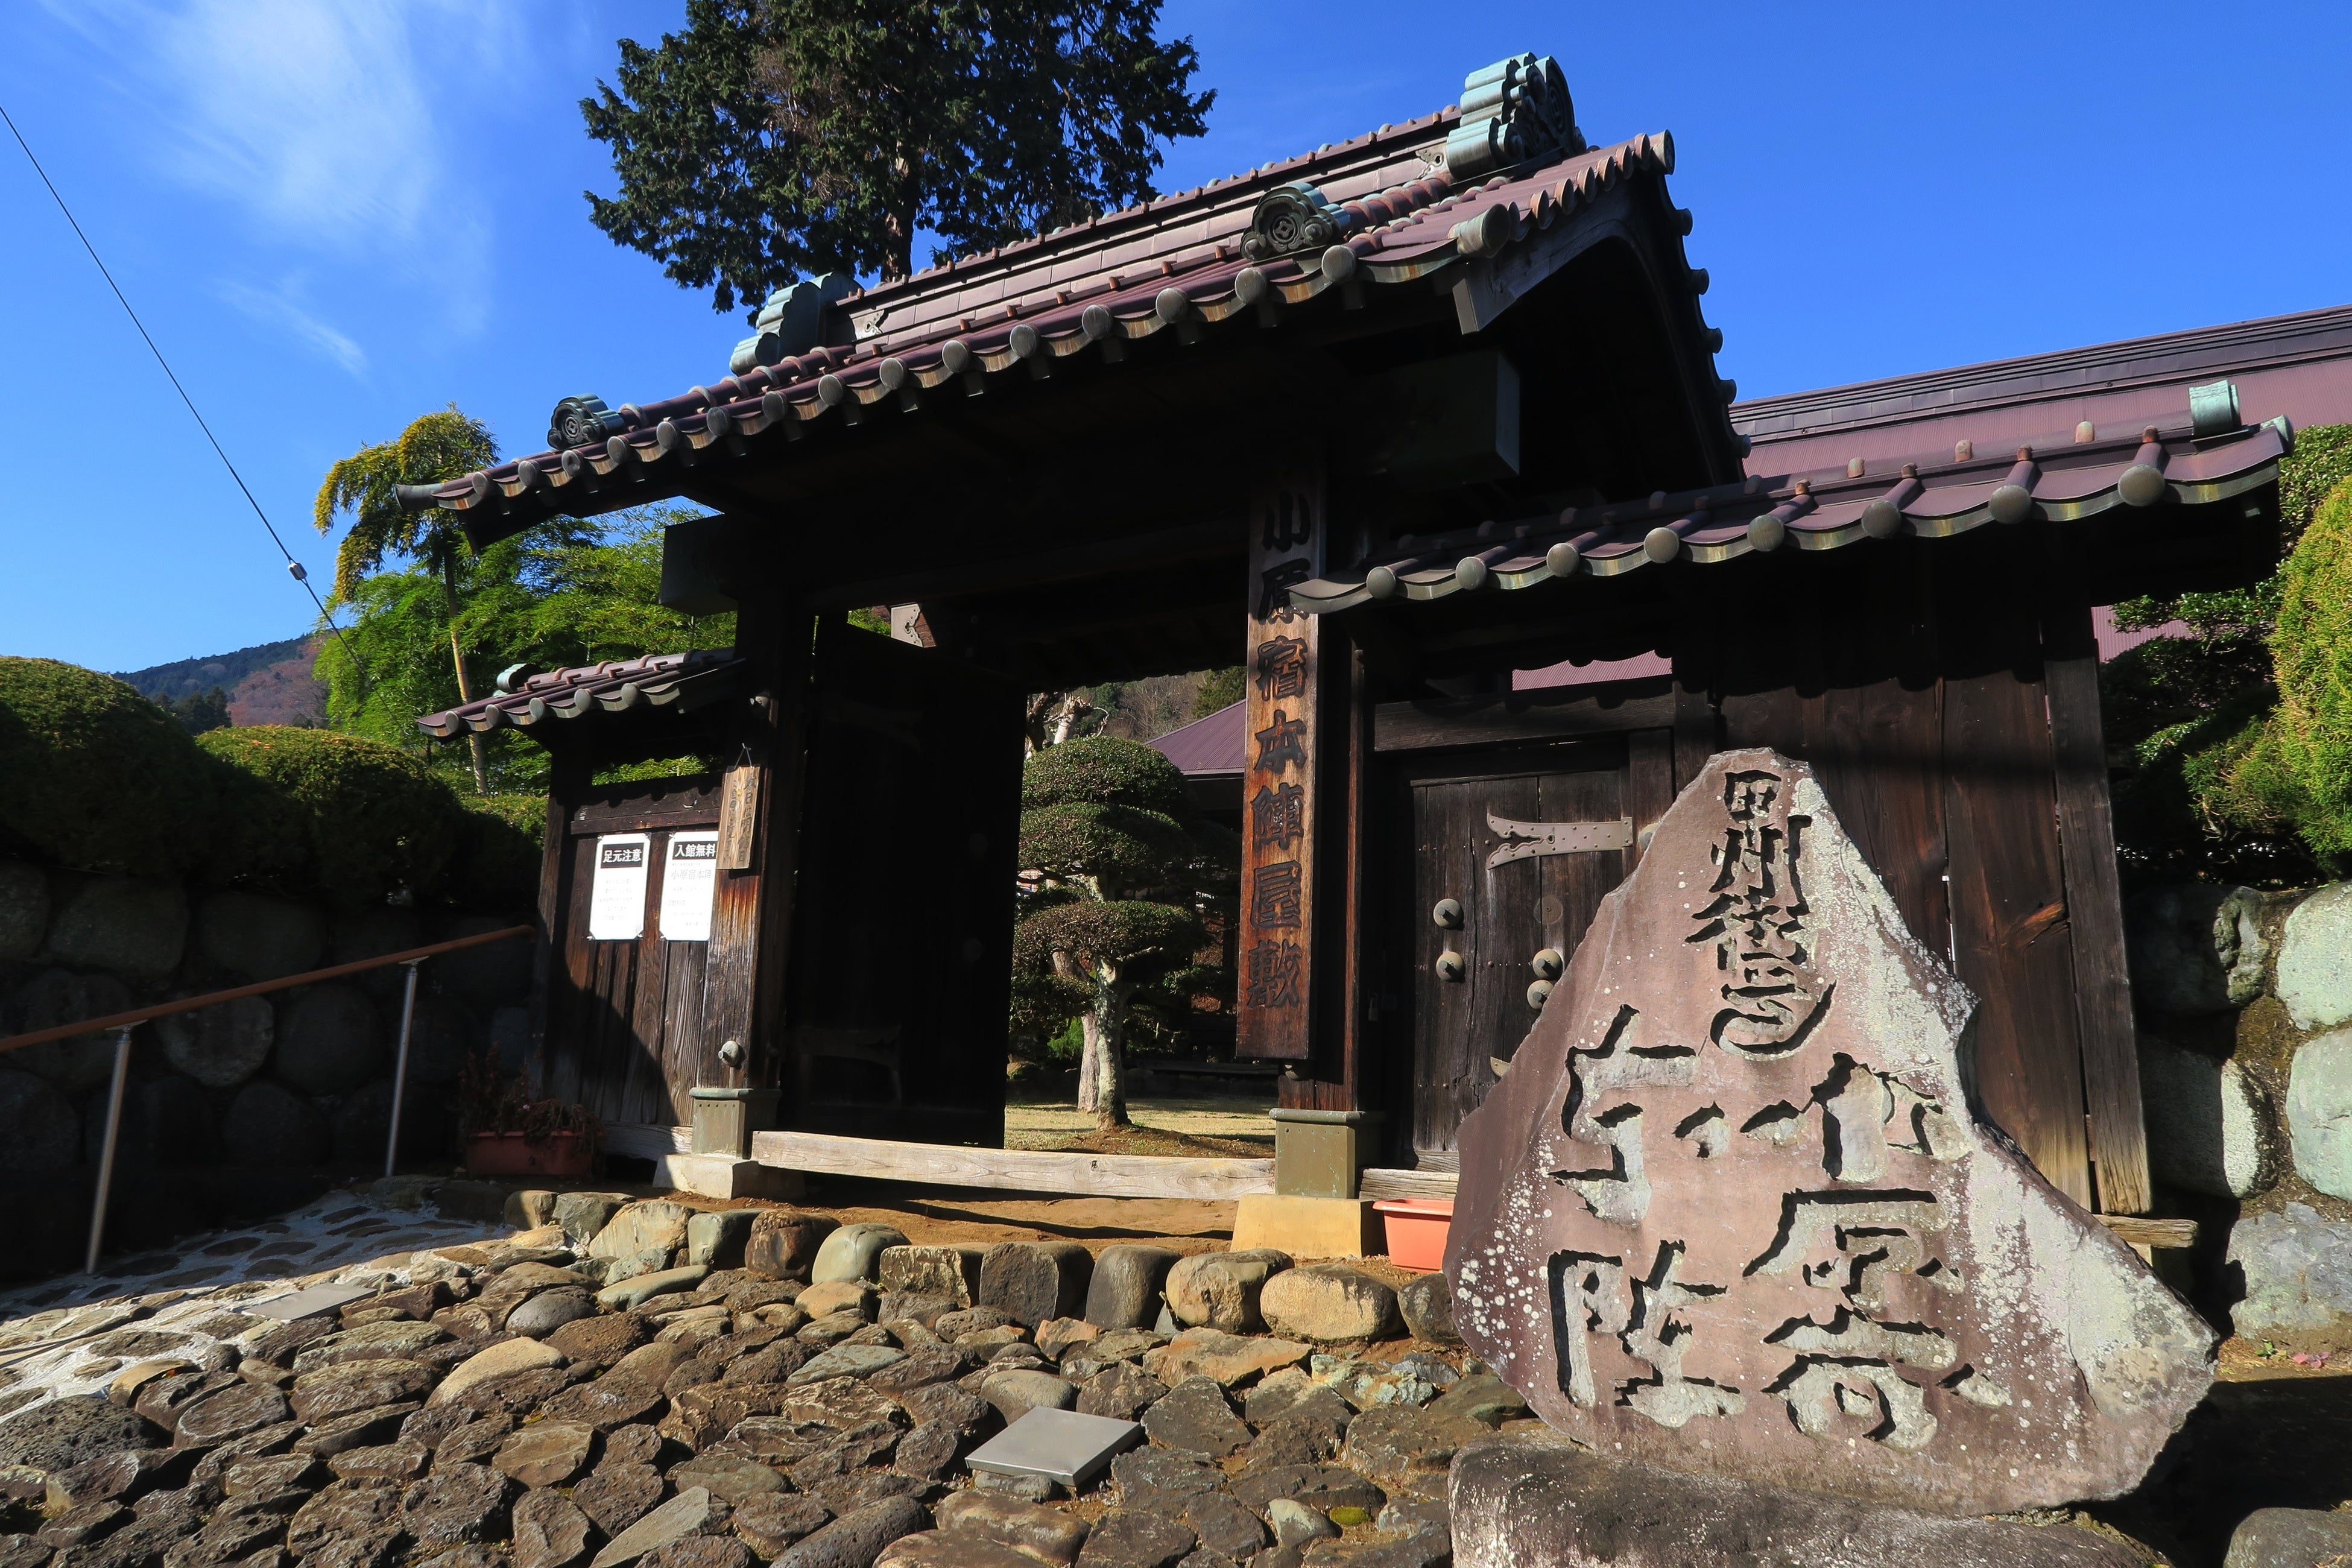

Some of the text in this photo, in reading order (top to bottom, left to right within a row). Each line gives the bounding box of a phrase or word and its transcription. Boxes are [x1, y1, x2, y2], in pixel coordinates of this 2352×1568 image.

[1247, 490, 1310, 1009] 小原宿本陣屋敷
[603, 849, 642, 863] 足元注意
[675, 843, 716, 858] 入館無料
[671, 868, 712, 880] 小原宿本陣
[1684, 770, 1837, 1061] 甲州街道
